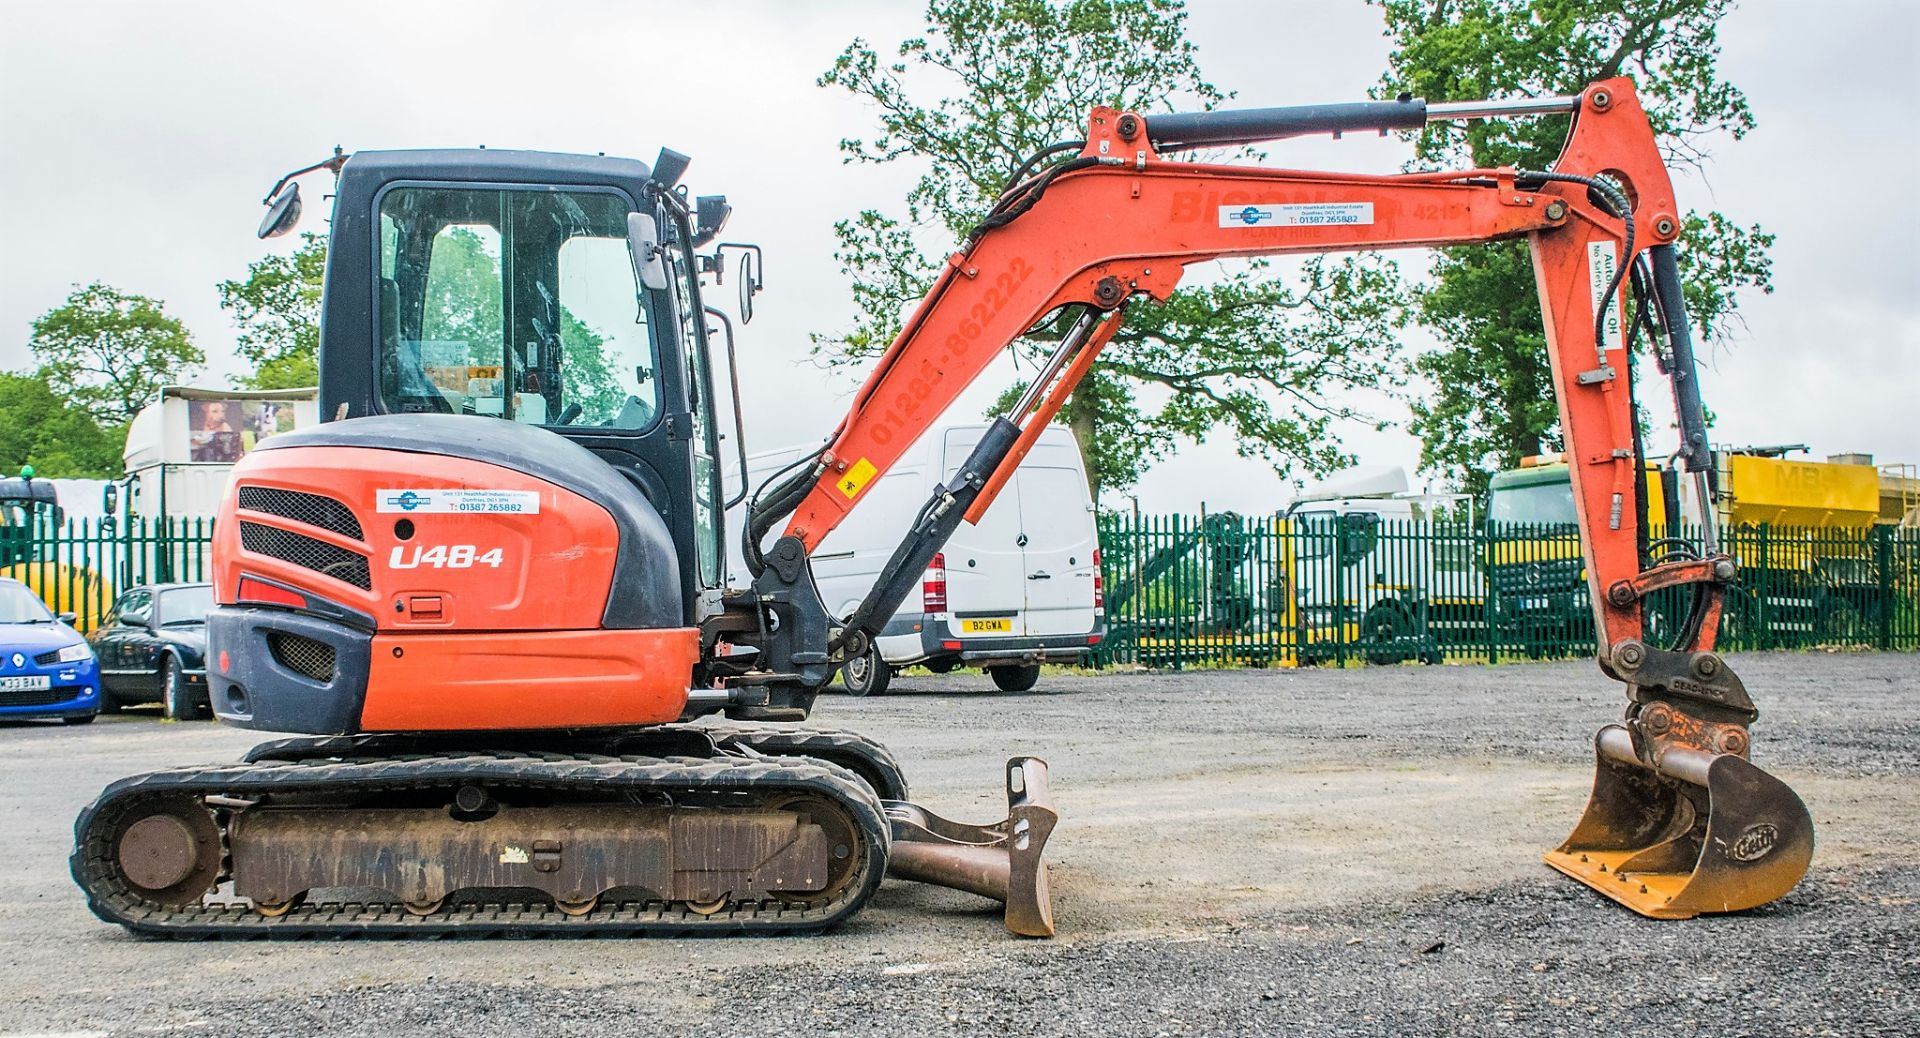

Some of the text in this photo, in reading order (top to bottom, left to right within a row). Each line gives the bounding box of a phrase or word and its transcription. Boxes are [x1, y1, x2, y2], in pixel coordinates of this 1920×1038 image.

[1299, 216, 1324, 224] 01387
[1326, 215, 1358, 223] 265882
[1593, 245, 1600, 258] No
[1594, 260, 1603, 290] Safety
[1604, 254, 1618, 335] Autotic QH
[459, 503, 486, 511] 01387
[488, 503, 522, 511] 265882
[973, 619, 1003, 631] B2 GWA
